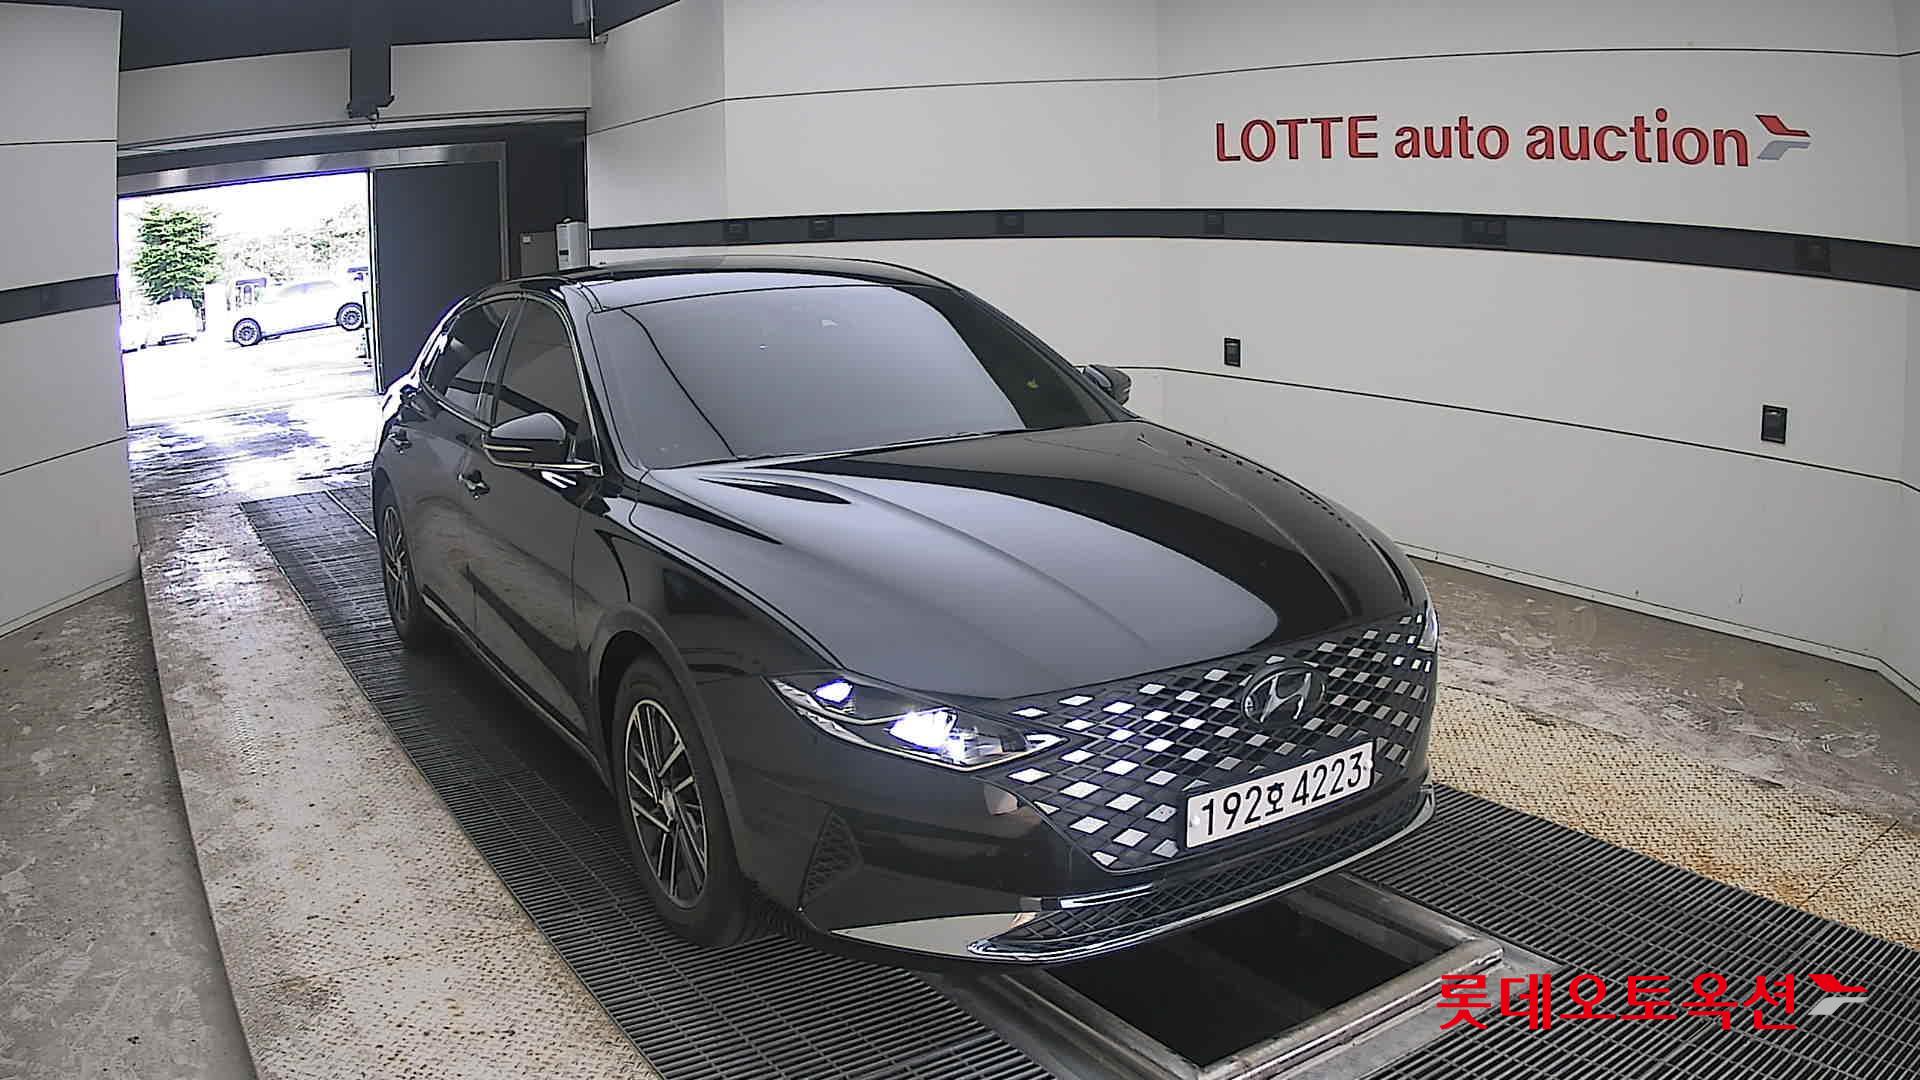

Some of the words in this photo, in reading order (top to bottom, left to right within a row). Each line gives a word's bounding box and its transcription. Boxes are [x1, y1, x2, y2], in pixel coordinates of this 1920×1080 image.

[1215, 115, 1378, 162] LOTTE
[1394, 115, 1510, 160] auto
[1525, 108, 1750, 167] auction
